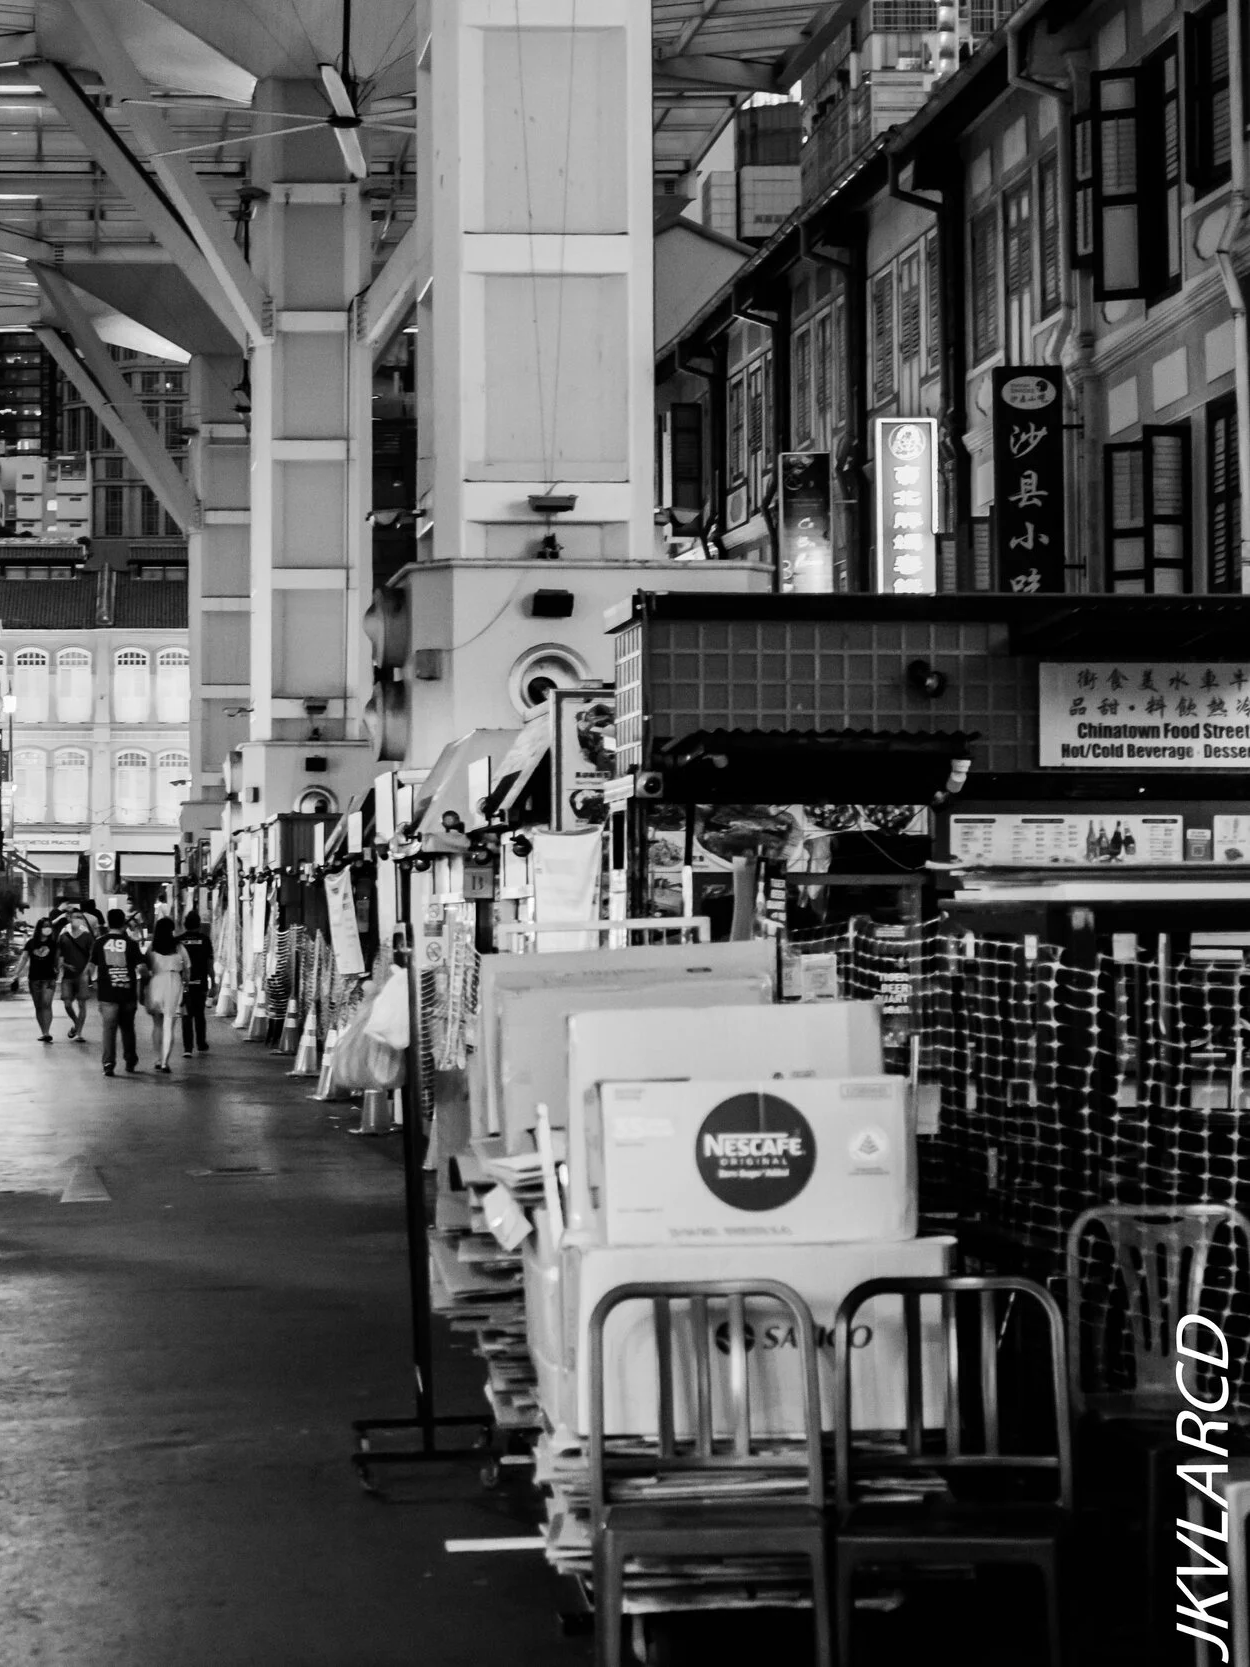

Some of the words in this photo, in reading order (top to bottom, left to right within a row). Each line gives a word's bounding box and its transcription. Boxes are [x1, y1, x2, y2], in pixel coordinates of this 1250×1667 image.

[1076, 722, 1161, 740] Chinatown
[1163, 722, 1200, 740] Food
[1203, 722, 1250, 740] Street
[1061, 743, 1124, 759] Hot/Cold
[1126, 743, 1194, 761] Beverage
[1203, 743, 1250, 759] Desse
[103, 938, 127, 953] 49
[881, 983, 913, 994] BEER
[719, 1157, 789, 1167] ORIGINAL
